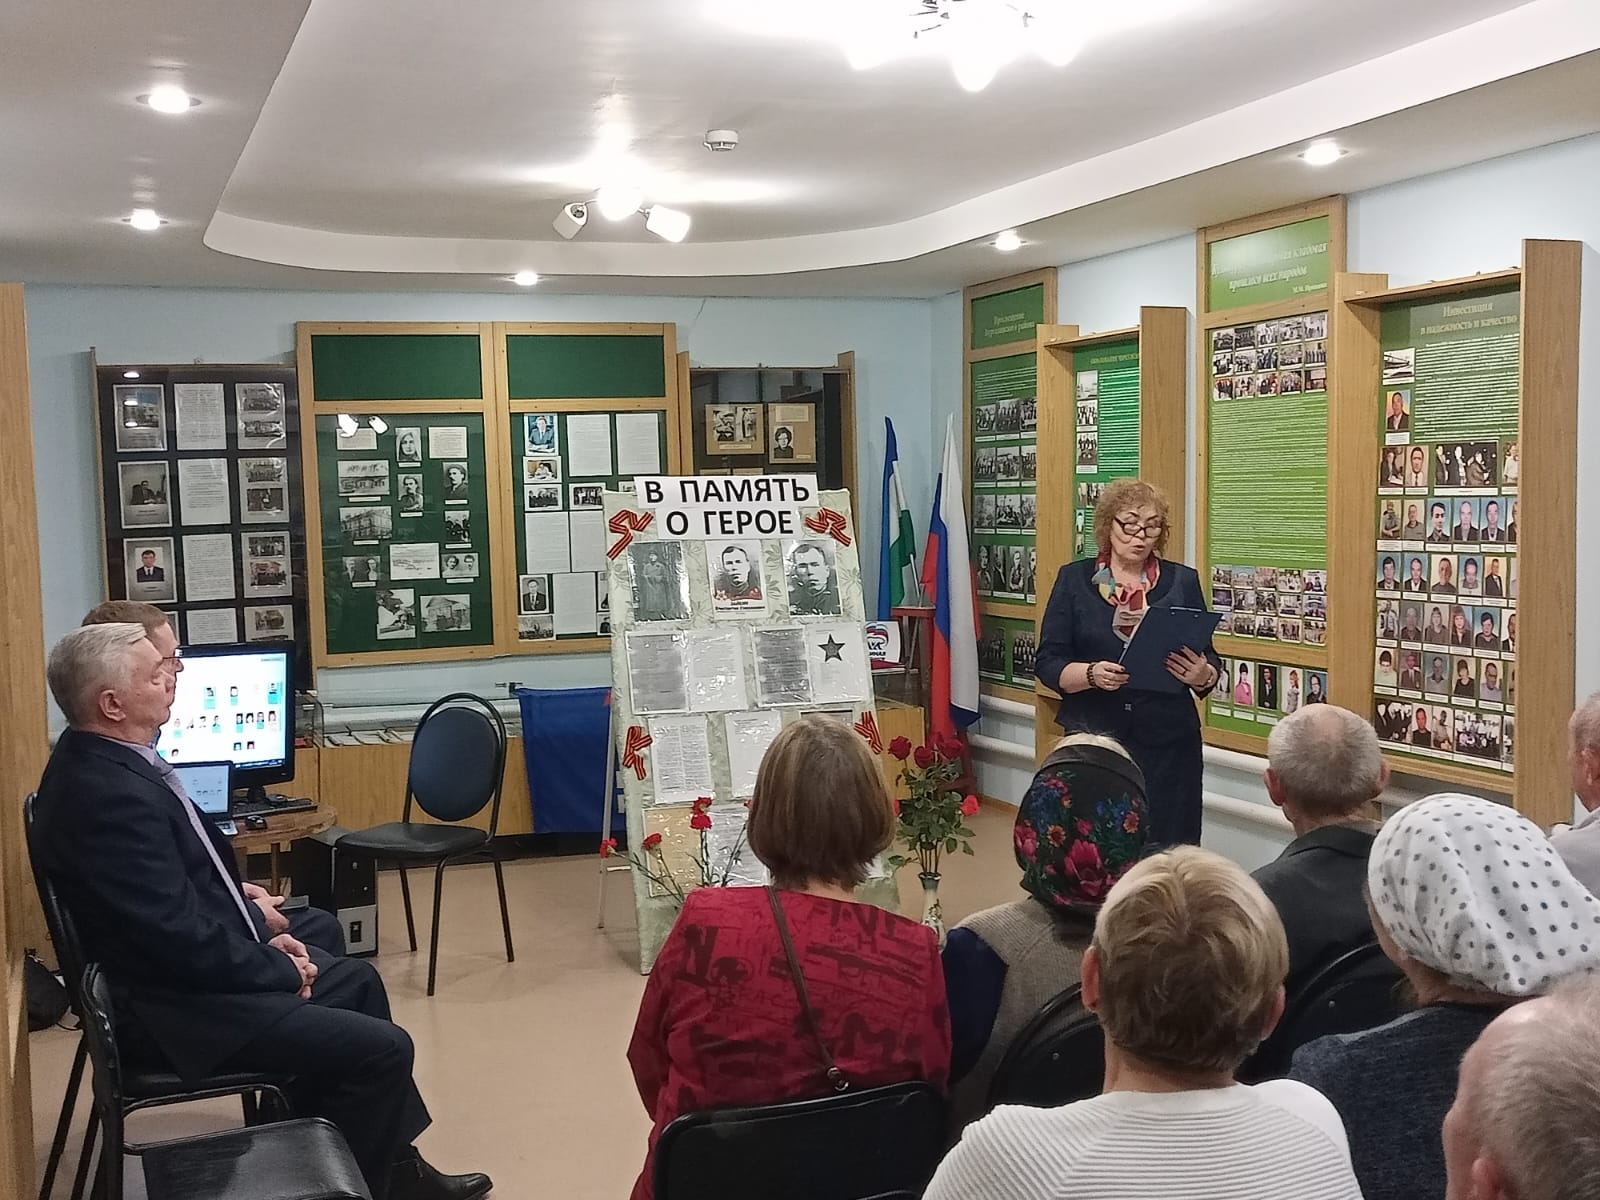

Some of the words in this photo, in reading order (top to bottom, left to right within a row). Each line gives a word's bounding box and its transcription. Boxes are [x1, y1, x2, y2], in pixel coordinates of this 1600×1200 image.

[645, 480, 664, 503] В
[679, 478, 810, 503] ПАМЯТЬ
[666, 511, 689, 536] О
[703, 509, 794, 535] ГЕРОЕ
